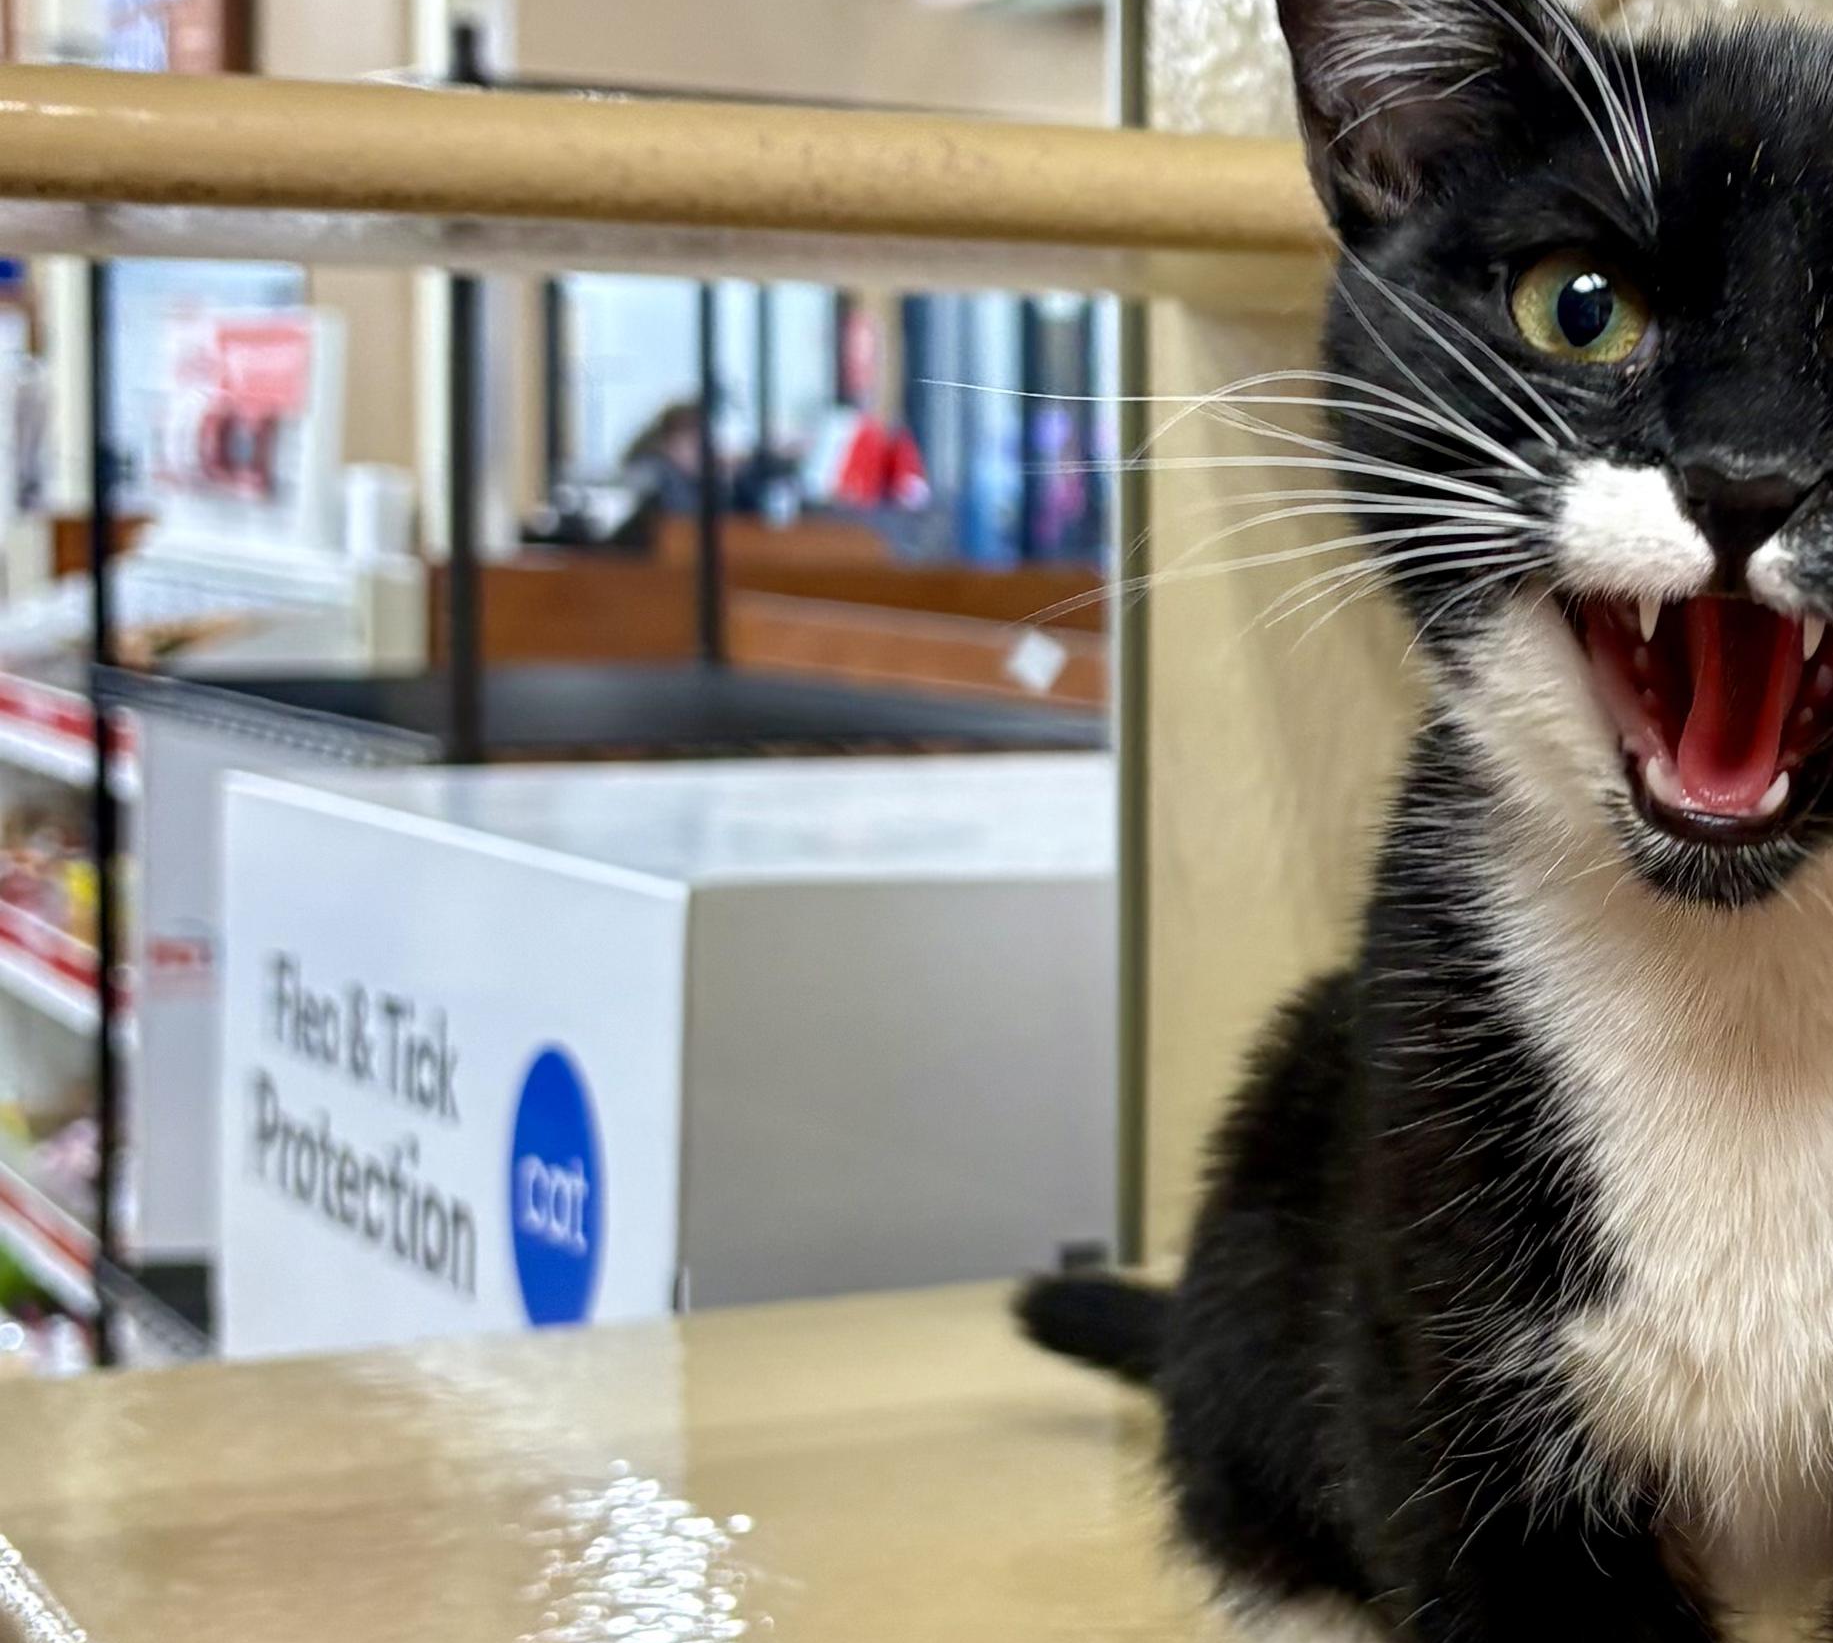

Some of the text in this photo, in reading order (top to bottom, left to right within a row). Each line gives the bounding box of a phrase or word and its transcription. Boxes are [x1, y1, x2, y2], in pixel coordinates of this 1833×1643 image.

[270, 948, 463, 1127] Flea & Tick
[251, 1067, 480, 1304] Protection
[519, 1154, 590, 1257] cat
